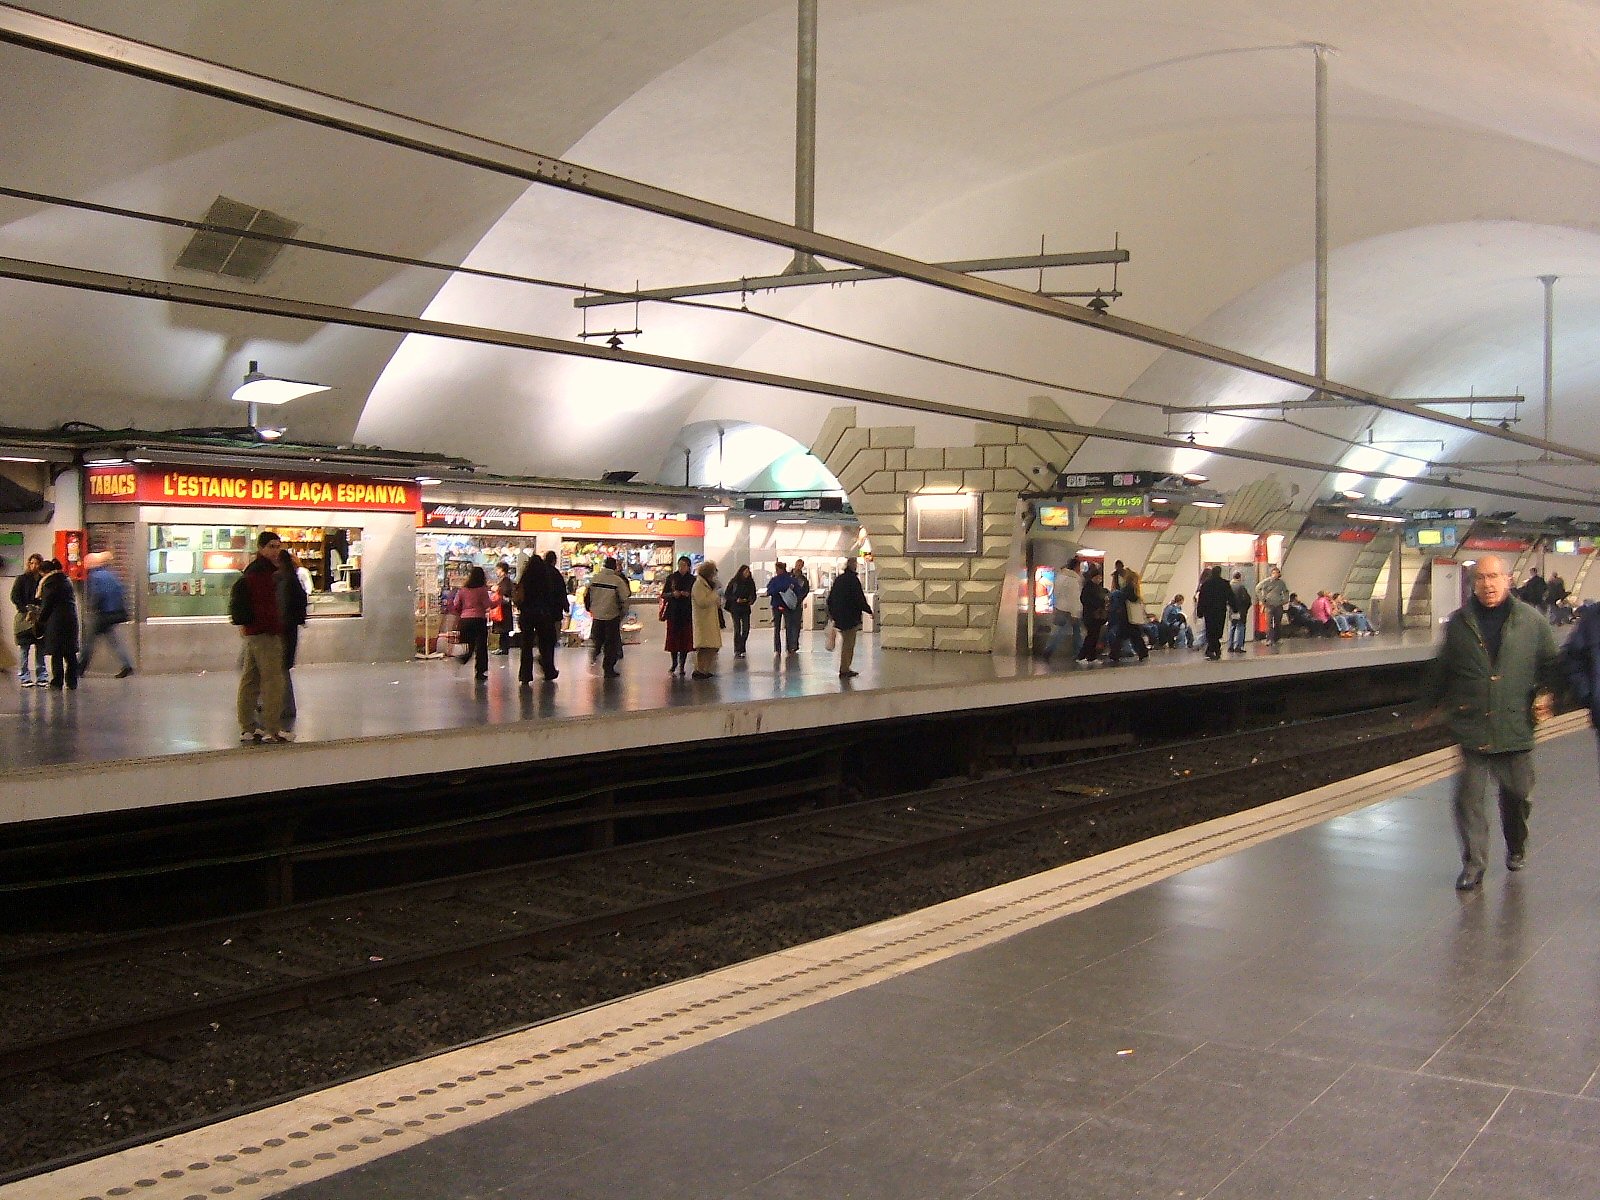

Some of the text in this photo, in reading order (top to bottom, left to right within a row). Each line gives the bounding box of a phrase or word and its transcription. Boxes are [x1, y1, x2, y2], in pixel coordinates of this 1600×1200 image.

[89, 474, 137, 495] TABACS
[163, 472, 407, 504] L'ESTANC DE PLAÇA ESPANYA
